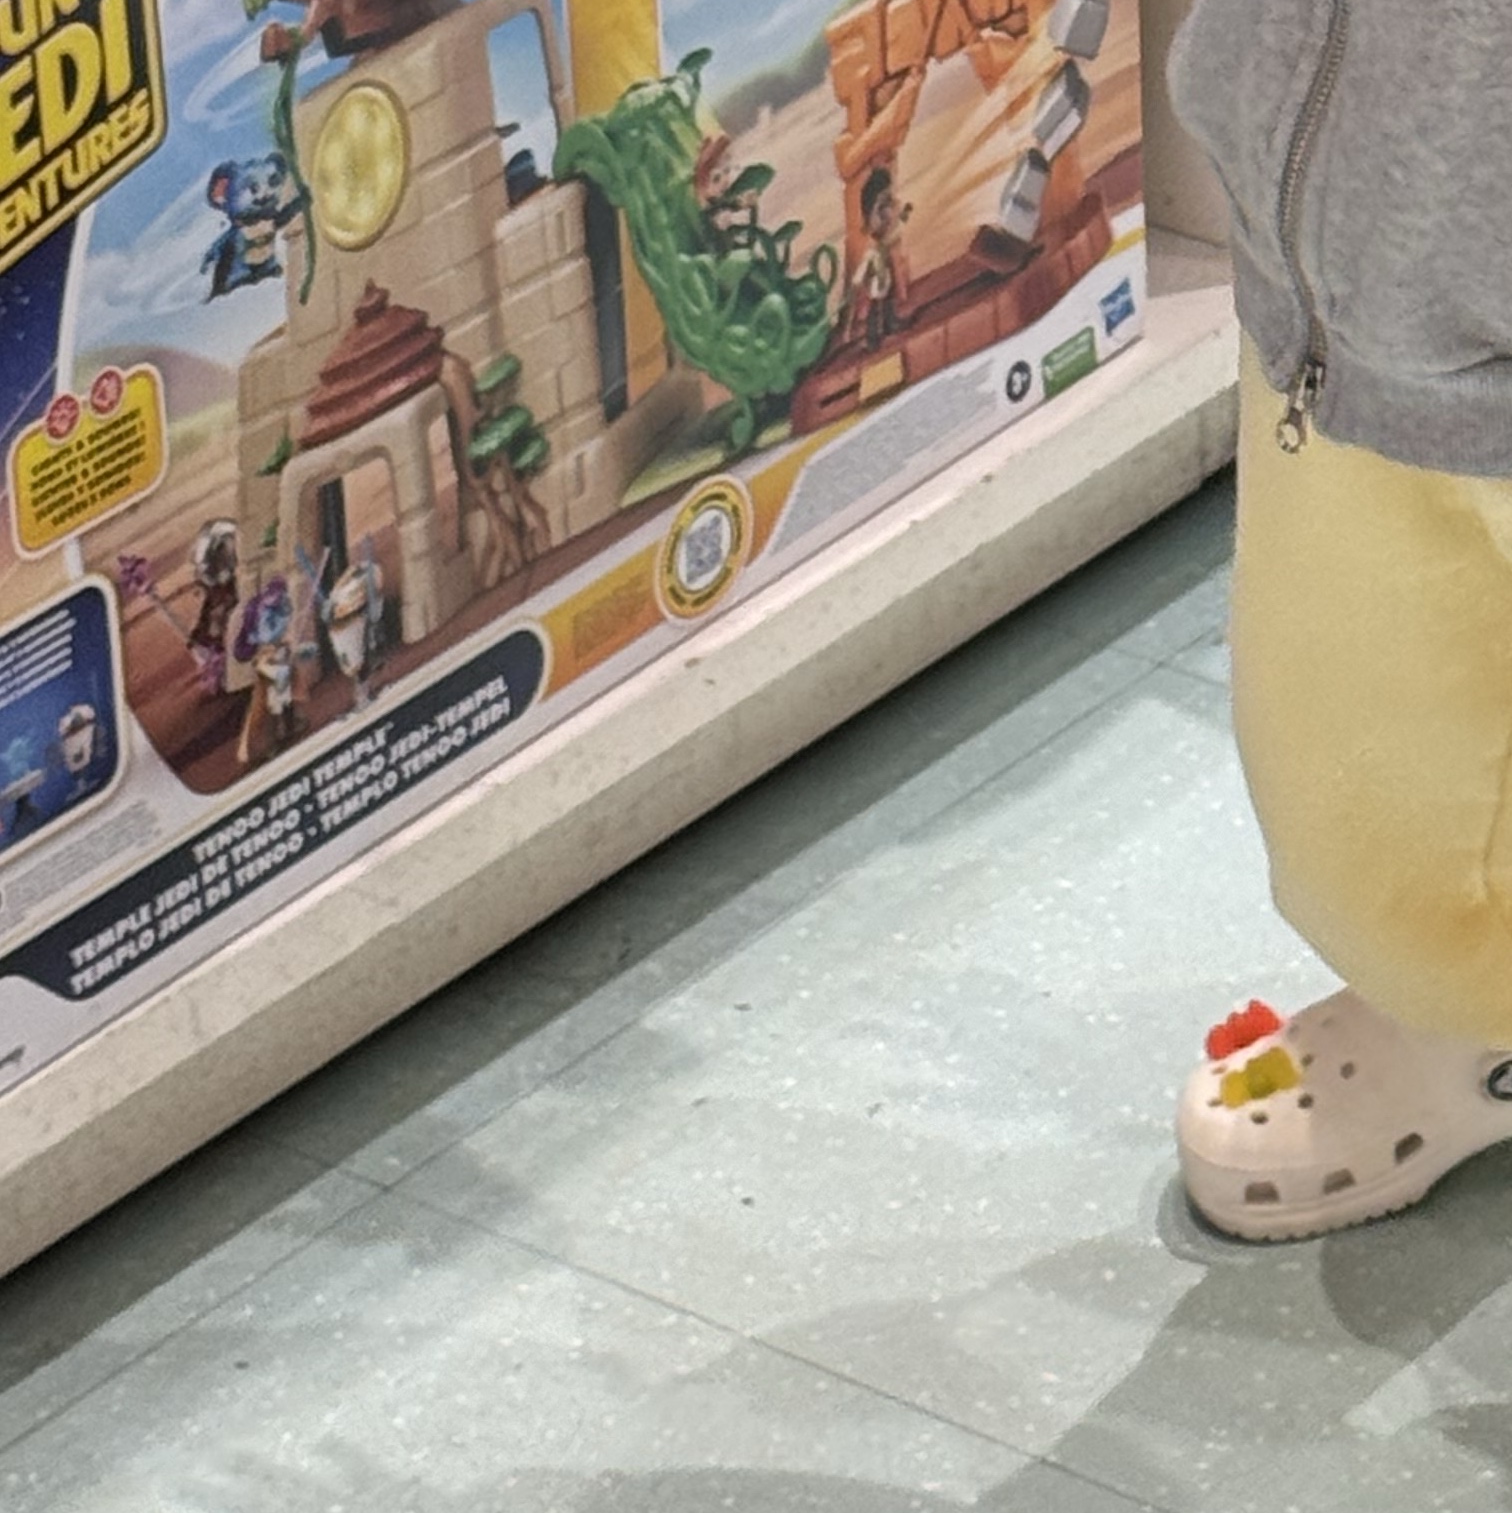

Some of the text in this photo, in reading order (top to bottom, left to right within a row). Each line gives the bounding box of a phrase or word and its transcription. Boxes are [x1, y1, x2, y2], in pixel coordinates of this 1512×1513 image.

[69, 696, 510, 995] TEMPLO JEDI DE TENOO TEMPLO TENOO JEDI
[69, 902, 152, 968] TEMPLE
[155, 873, 199, 915] JEDI
[202, 859, 229, 886] DE
[232, 808, 300, 865] TENOO
[316, 755, 385, 809] TENOO
[192, 807, 265, 862] TENOO
[268, 777, 311, 818] JEDI
[312, 727, 389, 786] TEMPLE
